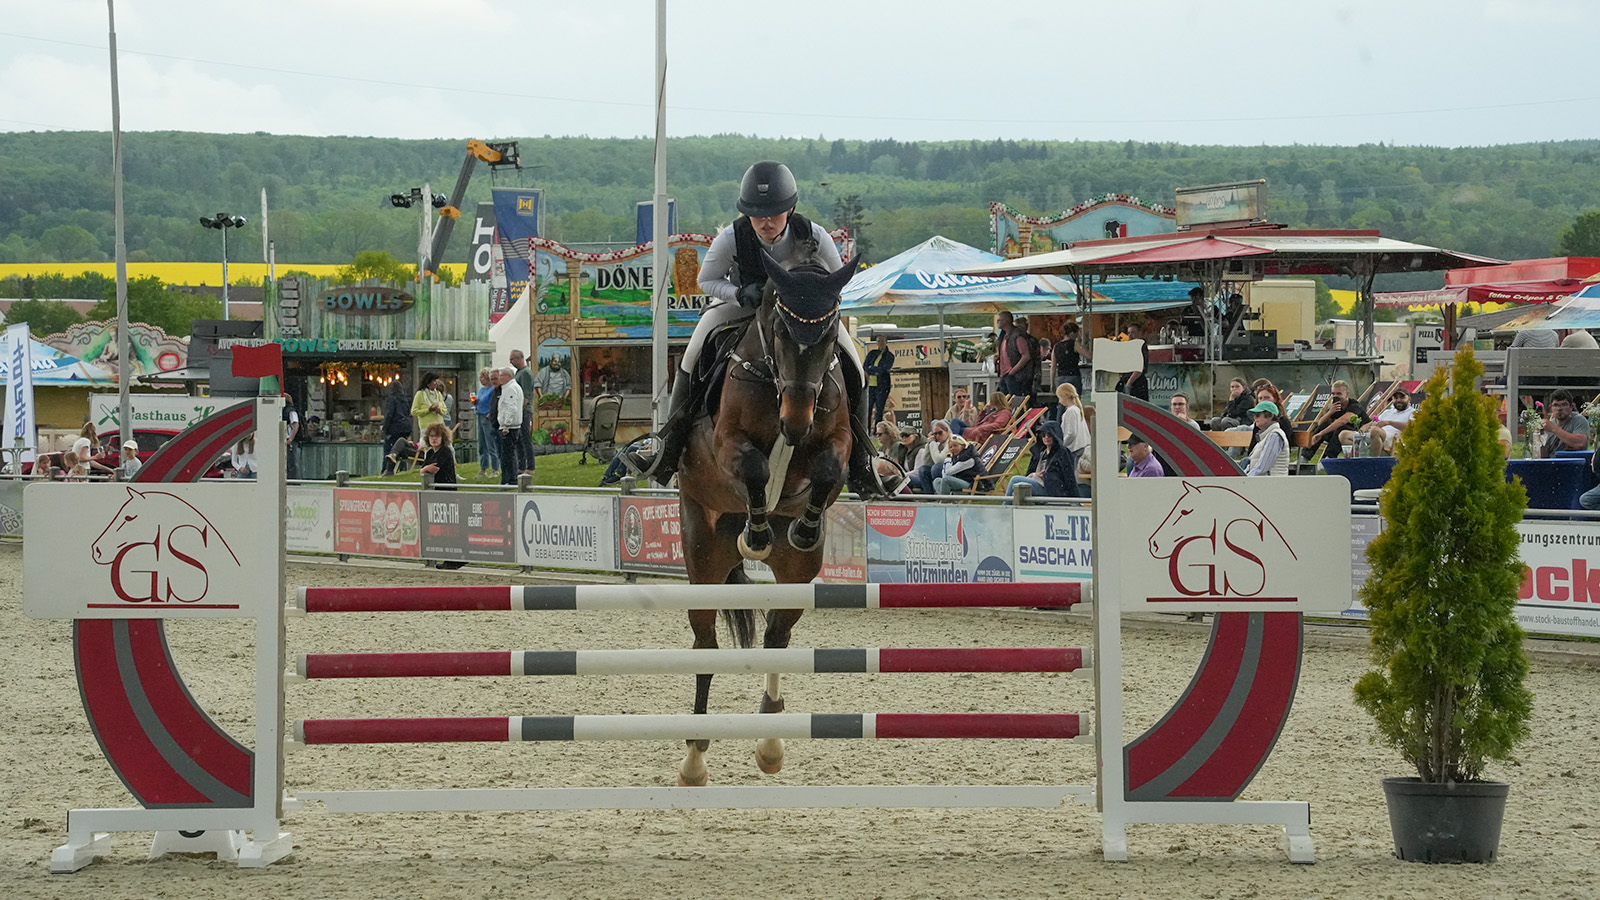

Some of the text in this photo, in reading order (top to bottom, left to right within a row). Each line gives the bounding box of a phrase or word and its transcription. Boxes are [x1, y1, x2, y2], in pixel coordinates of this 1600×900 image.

[596, 264, 673, 290] DÖNE
[324, 292, 404, 310] BOWLS
[651, 295, 715, 311] RAKE
[1418, 331, 1434, 339] PIZZA
[273, 338, 338, 353] BOWLS
[338, 341, 367, 351] CHICKEN
[369, 341, 399, 351] FALAFEL
[895, 349, 914, 357] PIZZA
[1383, 339, 1402, 352] LAND
[131, 407, 187, 422] asthaus
[427, 503, 460, 524] WESER-ITH
[668, 503, 680, 518] REITE
[528, 524, 593, 547] JUNGMANN
[1521, 533, 1600, 548] rungszentru
[905, 533, 964, 561] Stadtwerke
[1019, 545, 1093, 567] SASCHA M
[111, 524, 209, 603] GS
[1169, 518, 1266, 597] GS
[906, 560, 969, 583] Holzminden
